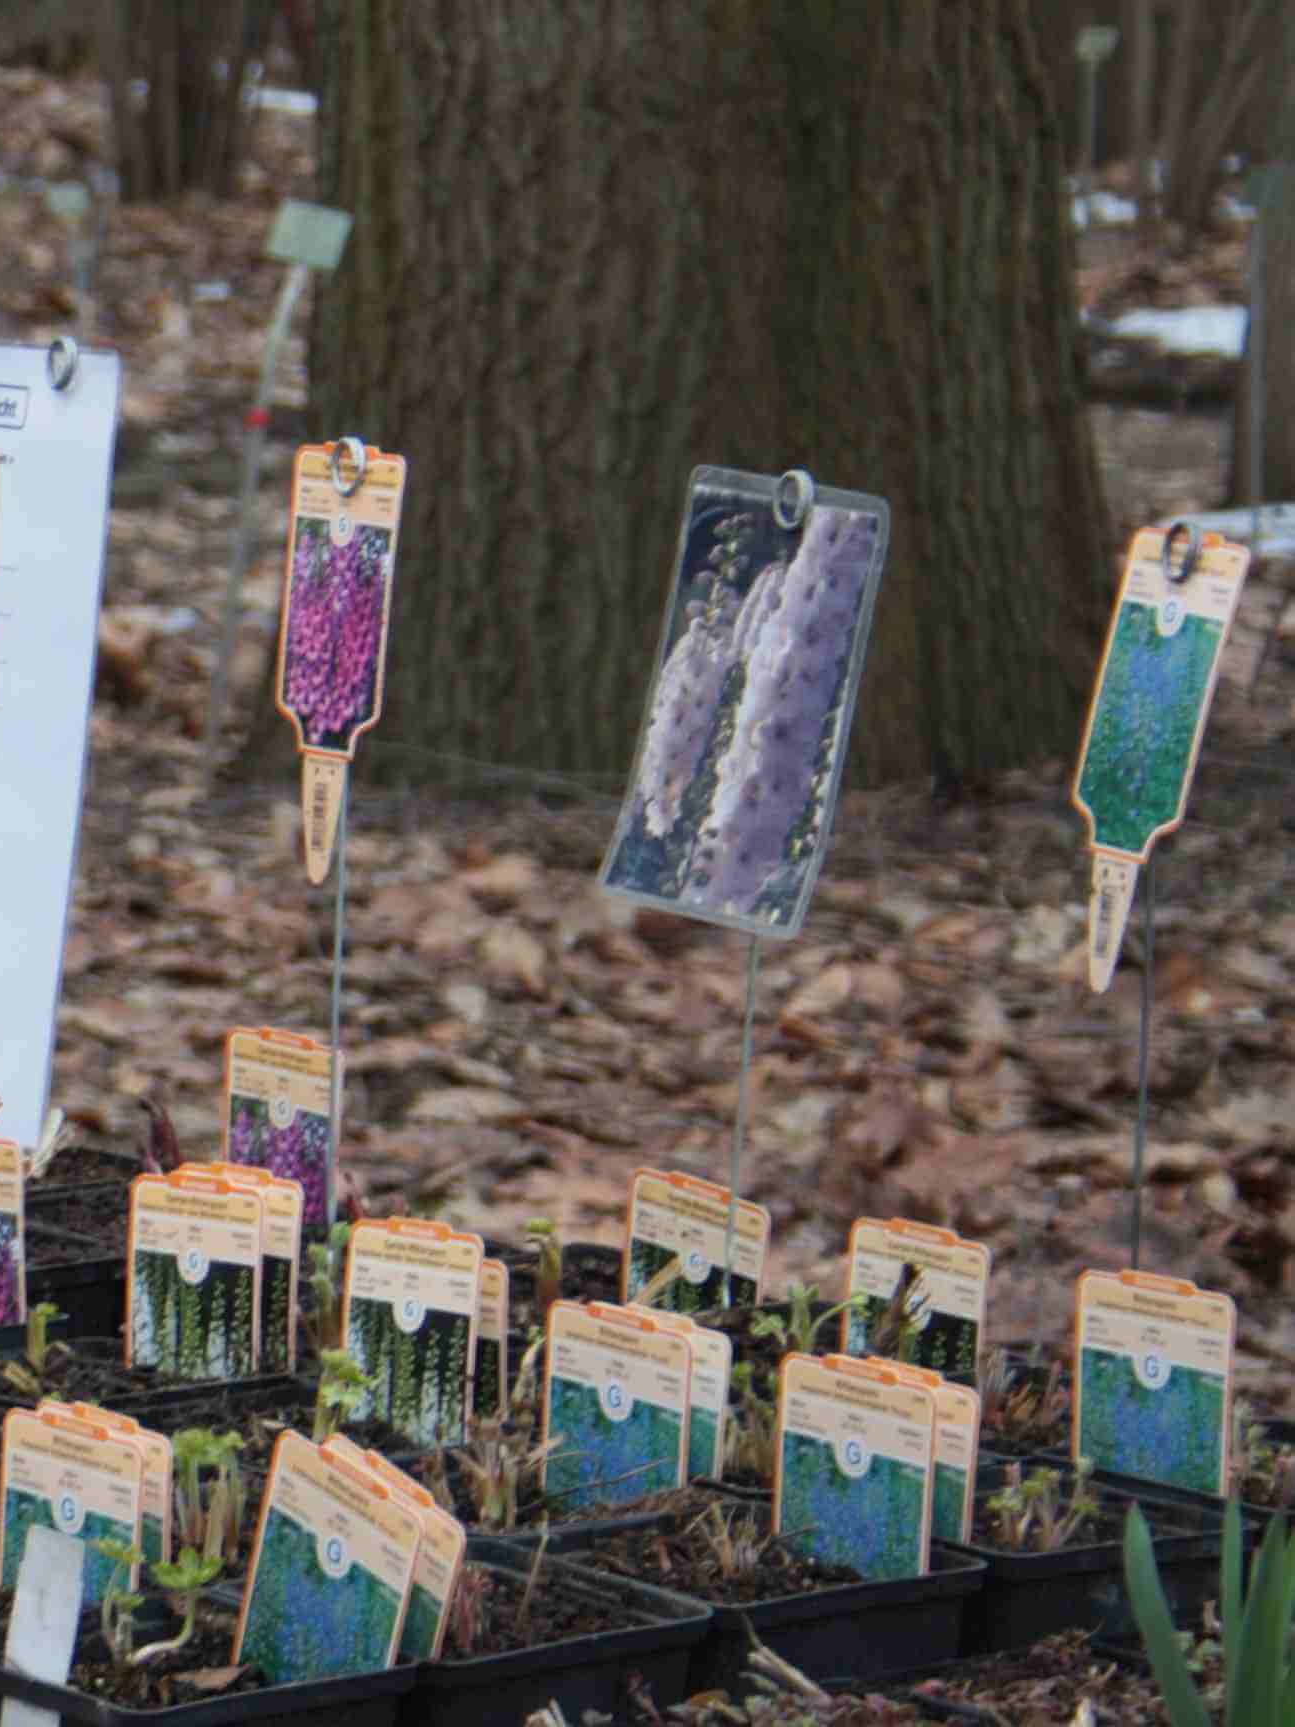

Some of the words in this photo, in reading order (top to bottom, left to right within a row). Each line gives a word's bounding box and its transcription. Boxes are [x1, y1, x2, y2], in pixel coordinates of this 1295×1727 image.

[1146, 1355, 1159, 1378] G
[609, 1385, 621, 1408] G
[846, 1441, 861, 1466] G
[60, 1496, 75, 1521] G
[326, 1537, 341, 1563] G
